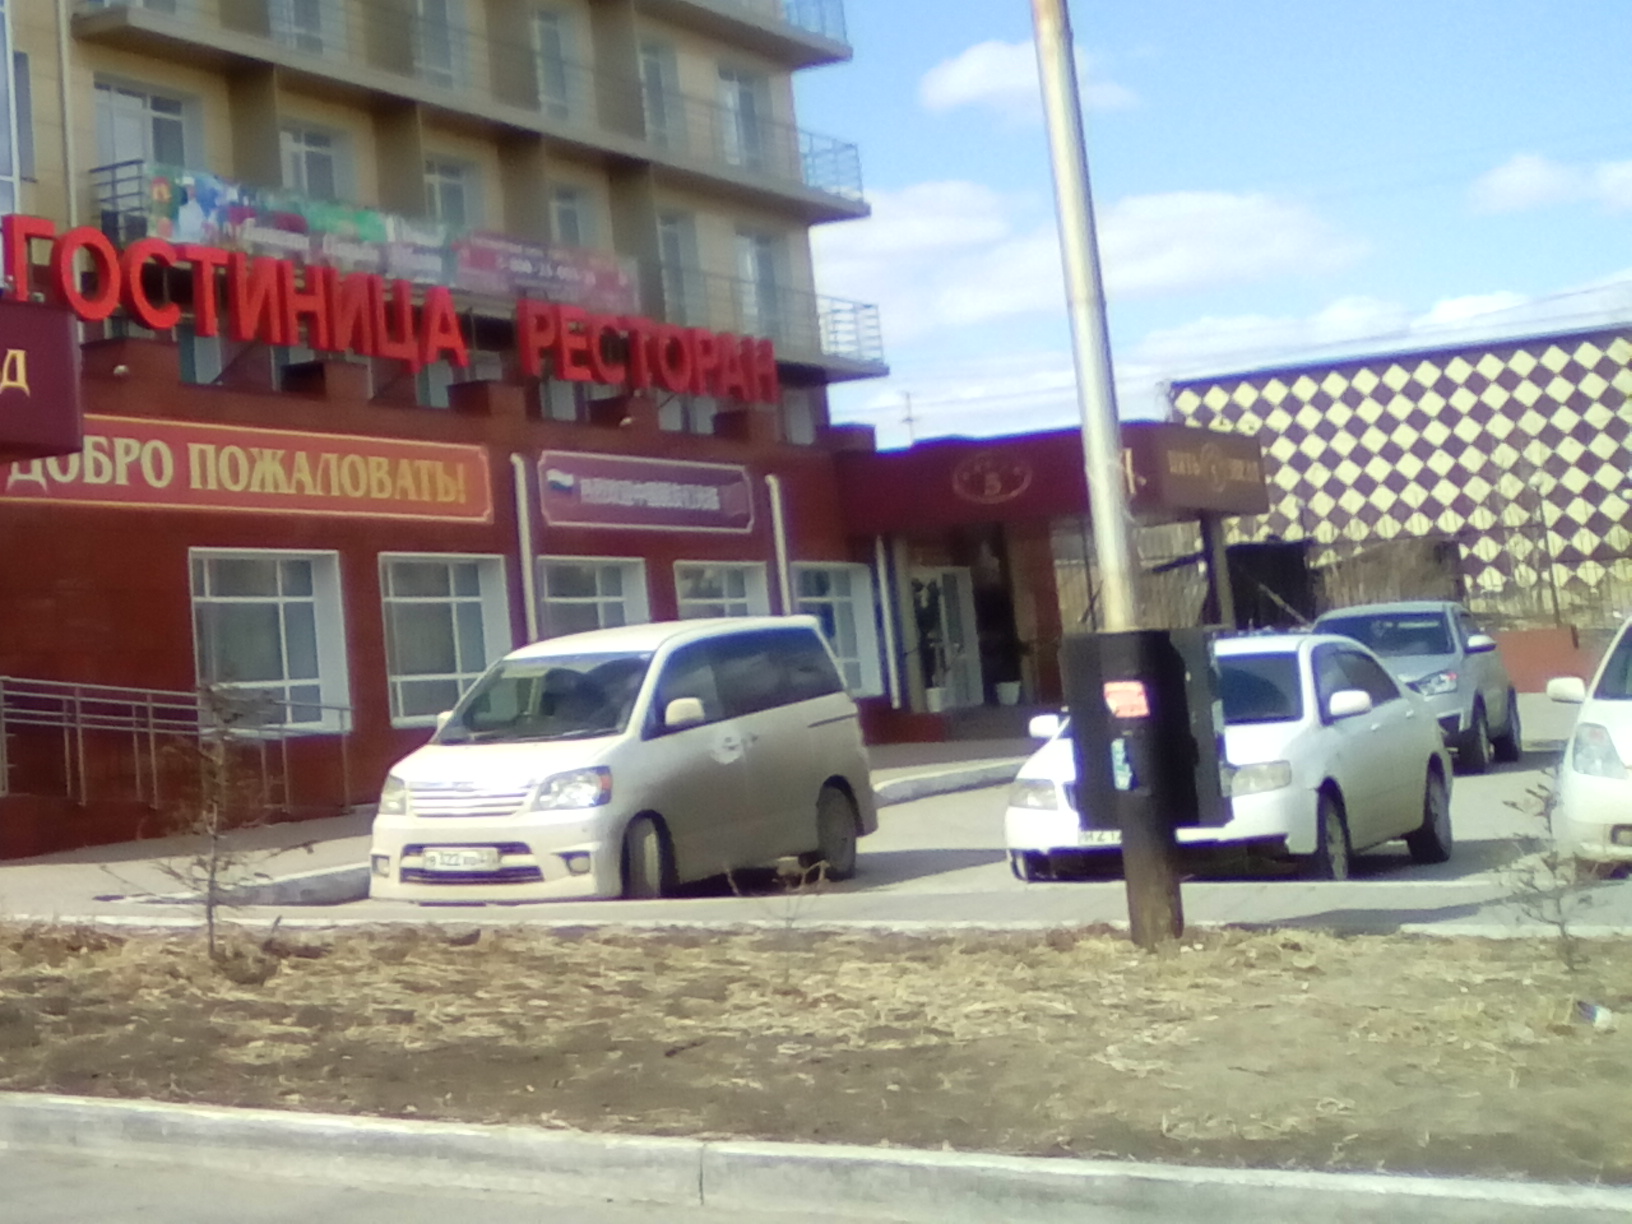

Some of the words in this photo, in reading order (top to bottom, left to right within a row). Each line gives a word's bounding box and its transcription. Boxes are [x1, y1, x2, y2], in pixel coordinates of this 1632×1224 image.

[2, 214, 468, 373] ГОСТИНИЦА
[515, 297, 779, 403] РЕСТОРАН
[187, 442, 467, 504] ПОЖАЛОВАТЬ!
